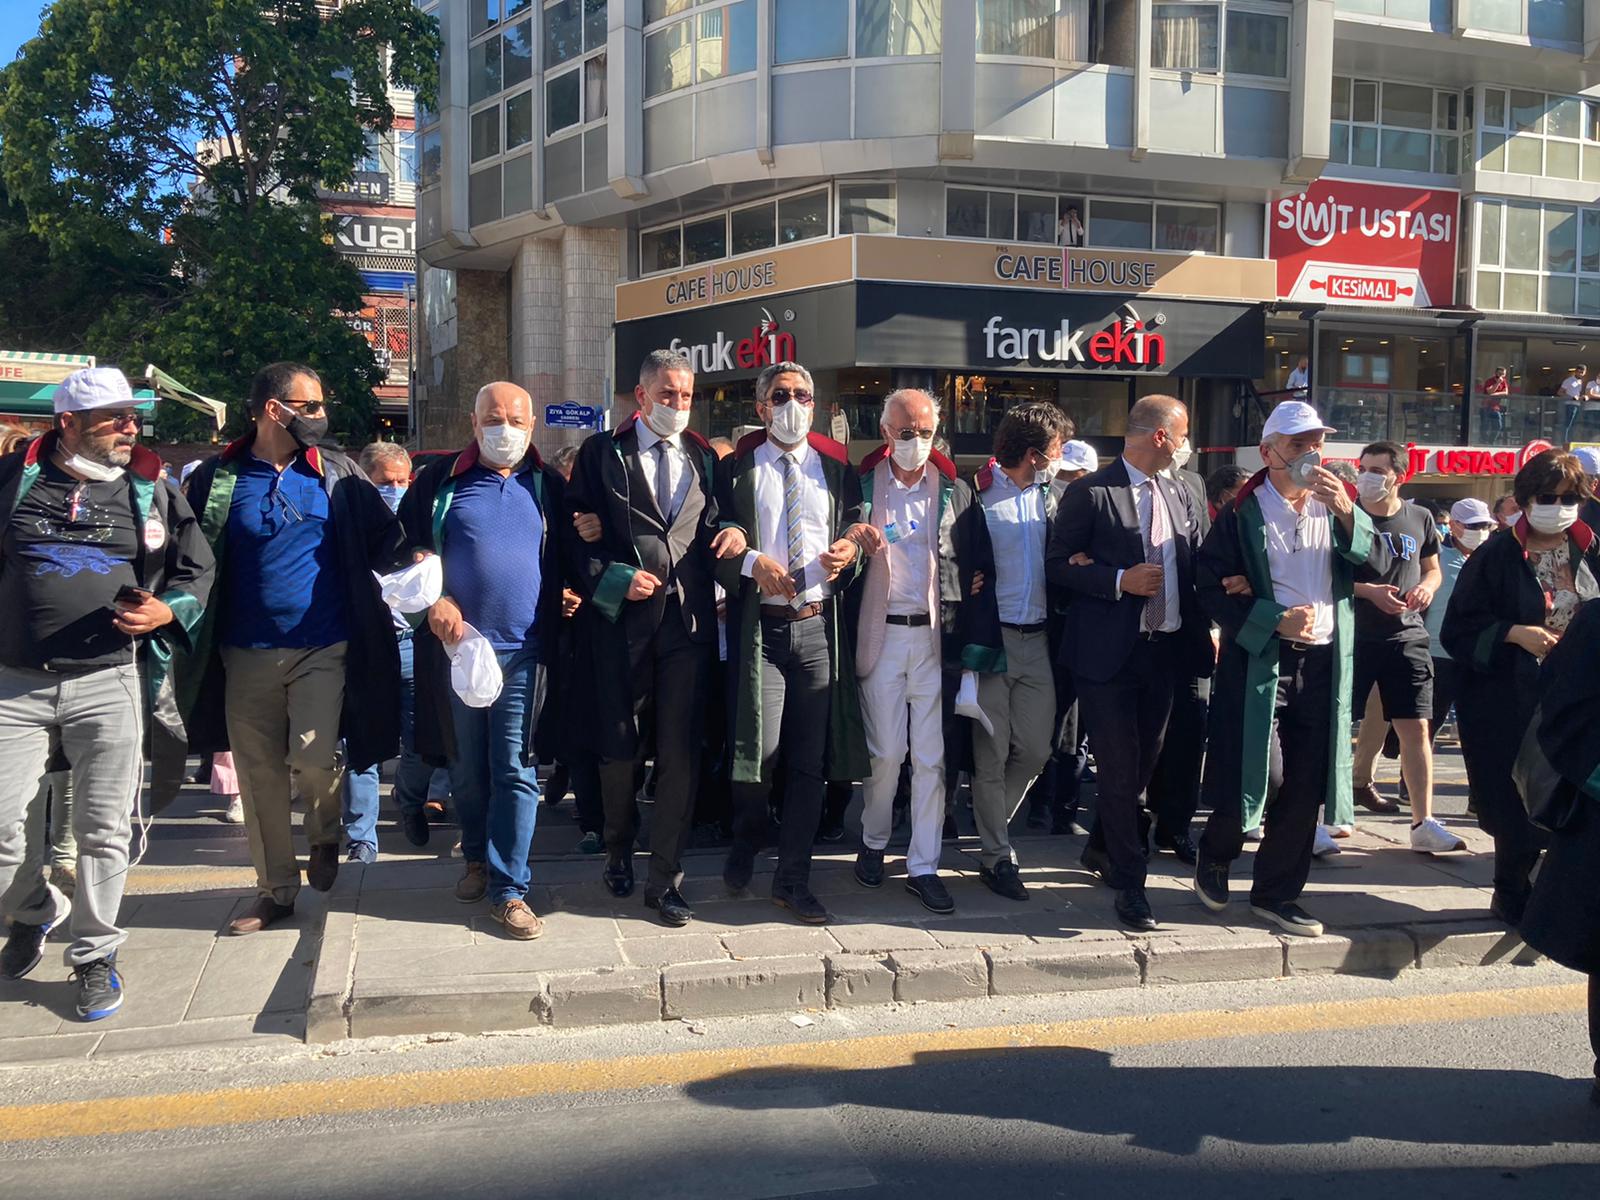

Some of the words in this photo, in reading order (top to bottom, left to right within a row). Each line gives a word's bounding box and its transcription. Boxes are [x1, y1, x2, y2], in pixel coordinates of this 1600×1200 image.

[337, 216, 416, 249] Kuaf
[1360, 207, 1451, 243] USTASI
[666, 277, 706, 305] CAFE
[712, 261, 775, 297] HOUSE
[994, 254, 1062, 281] CAFE
[1069, 258, 1157, 288] HOUSE
[736, 321, 796, 369] ekin
[983, 316, 1085, 362] faruk
[1089, 319, 1166, 366] ekin
[1436, 450, 1516, 475] USTASI
